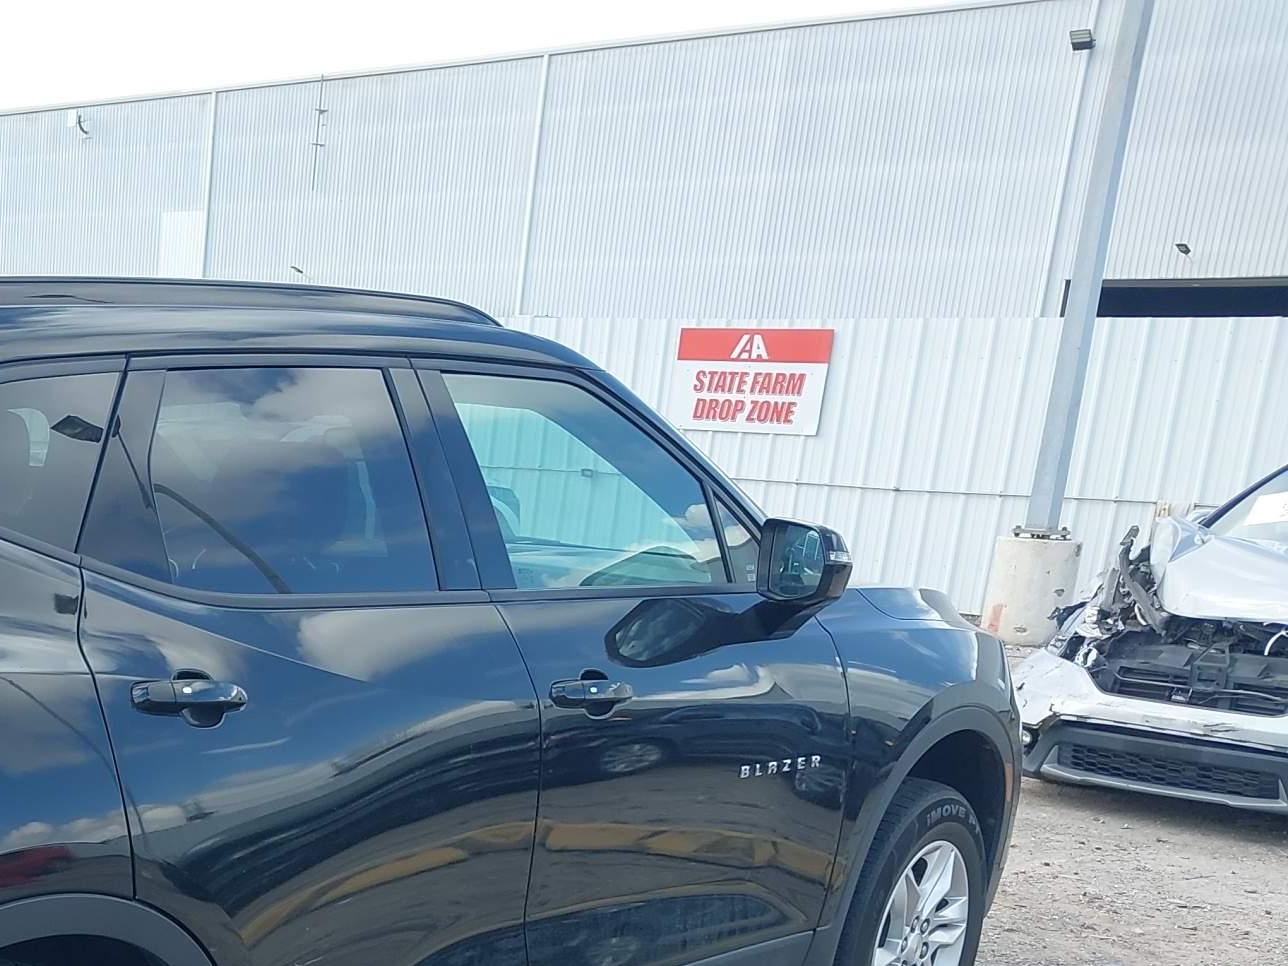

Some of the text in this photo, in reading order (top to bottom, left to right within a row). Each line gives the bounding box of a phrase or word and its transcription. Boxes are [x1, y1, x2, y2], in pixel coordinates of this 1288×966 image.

[693, 370, 807, 397] STATE FARM
[692, 398, 798, 425] DROP ZONE
[740, 755, 821, 778] BLAZER
